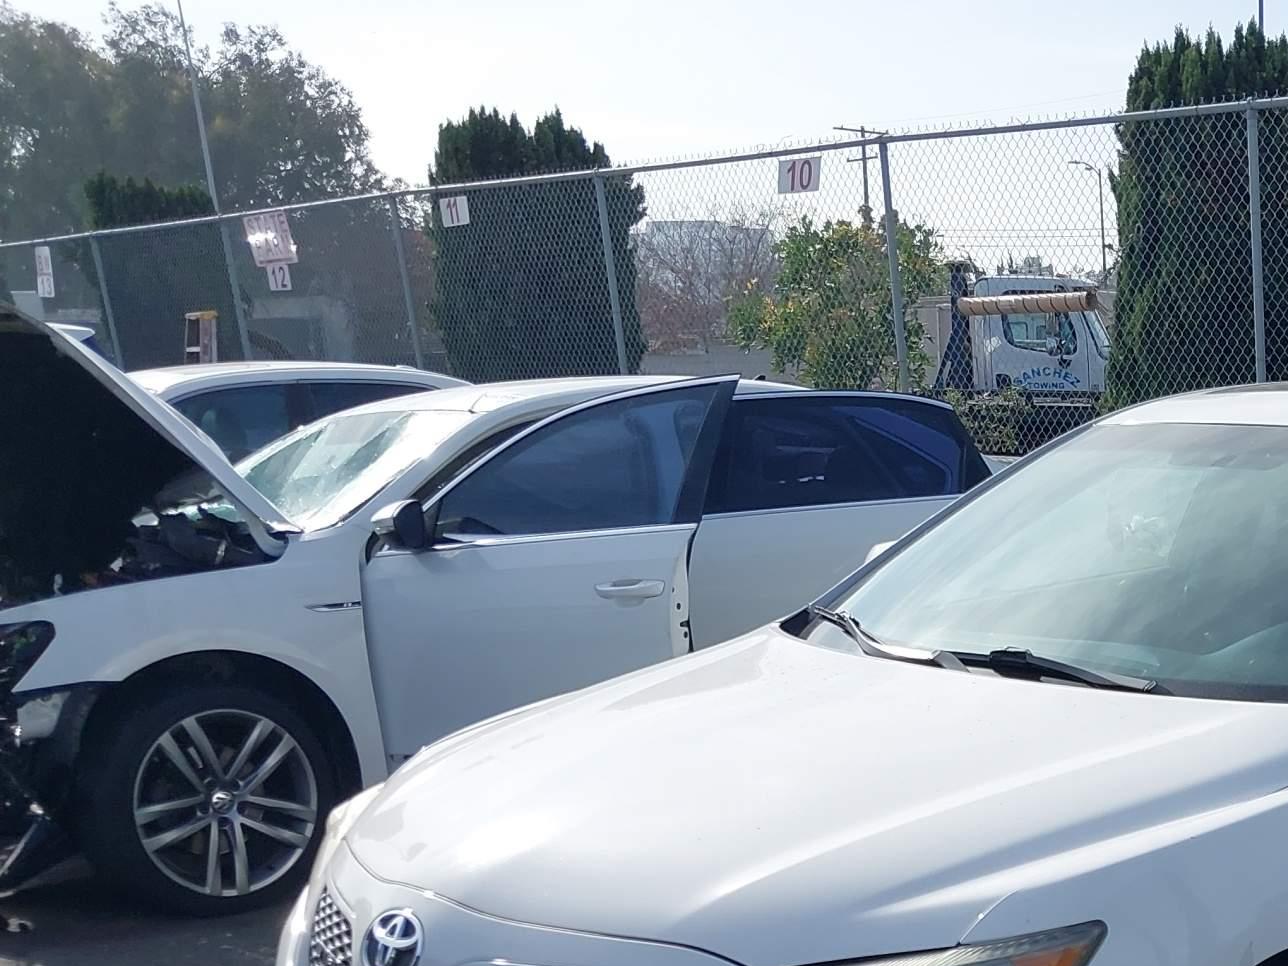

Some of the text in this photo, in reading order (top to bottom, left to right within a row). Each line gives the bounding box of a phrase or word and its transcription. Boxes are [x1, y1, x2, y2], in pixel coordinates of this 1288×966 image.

[787, 160, 813, 191] 10
[447, 198, 460, 224] 11
[271, 266, 288, 289] 12
[1013, 366, 1081, 388] SANCHEZ
[1027, 382, 1065, 390] TOWING
